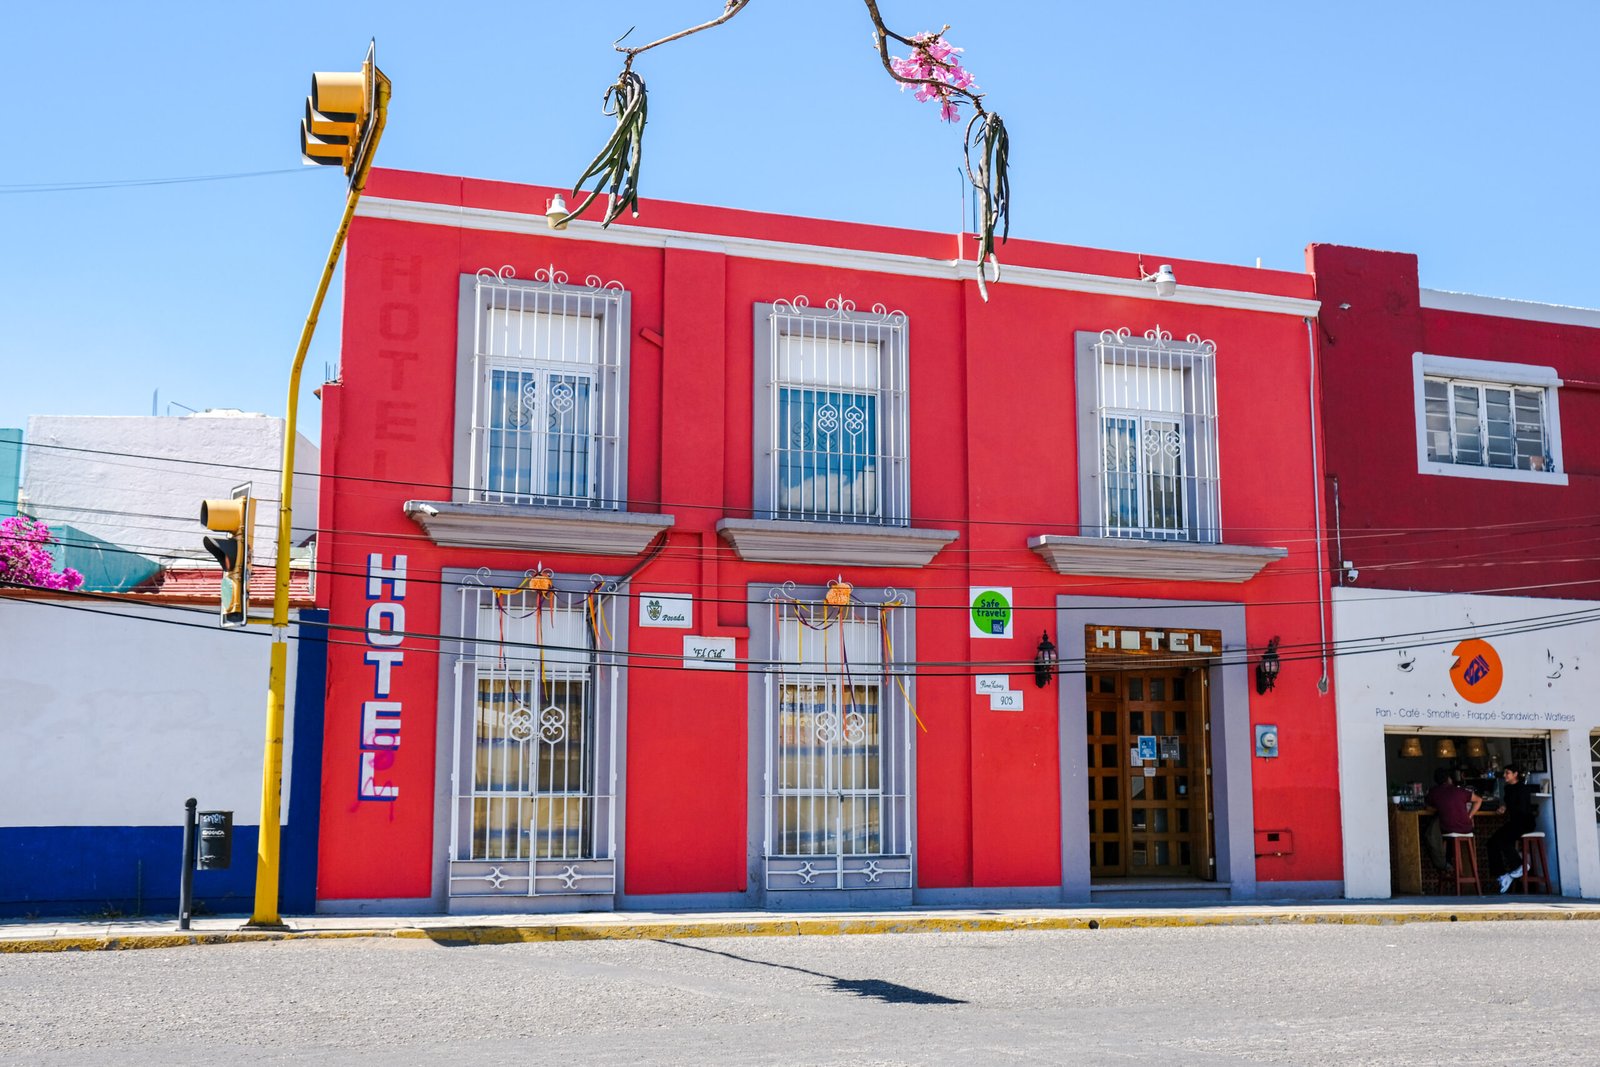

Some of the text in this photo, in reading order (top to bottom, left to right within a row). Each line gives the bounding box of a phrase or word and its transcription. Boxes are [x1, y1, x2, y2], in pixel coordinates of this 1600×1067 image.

[373, 251, 422, 492] HOTEL
[980, 599, 1000, 607] Safe
[662, 613, 685, 621] Posada
[977, 608, 1006, 617] travels
[1095, 629, 1214, 653] HOTEL
[358, 552, 408, 801] HOTEL
[1000, 695, 1014, 705] 905
[1375, 707, 1392, 718] Pan
[1501, 710, 1540, 721] Sandwich
